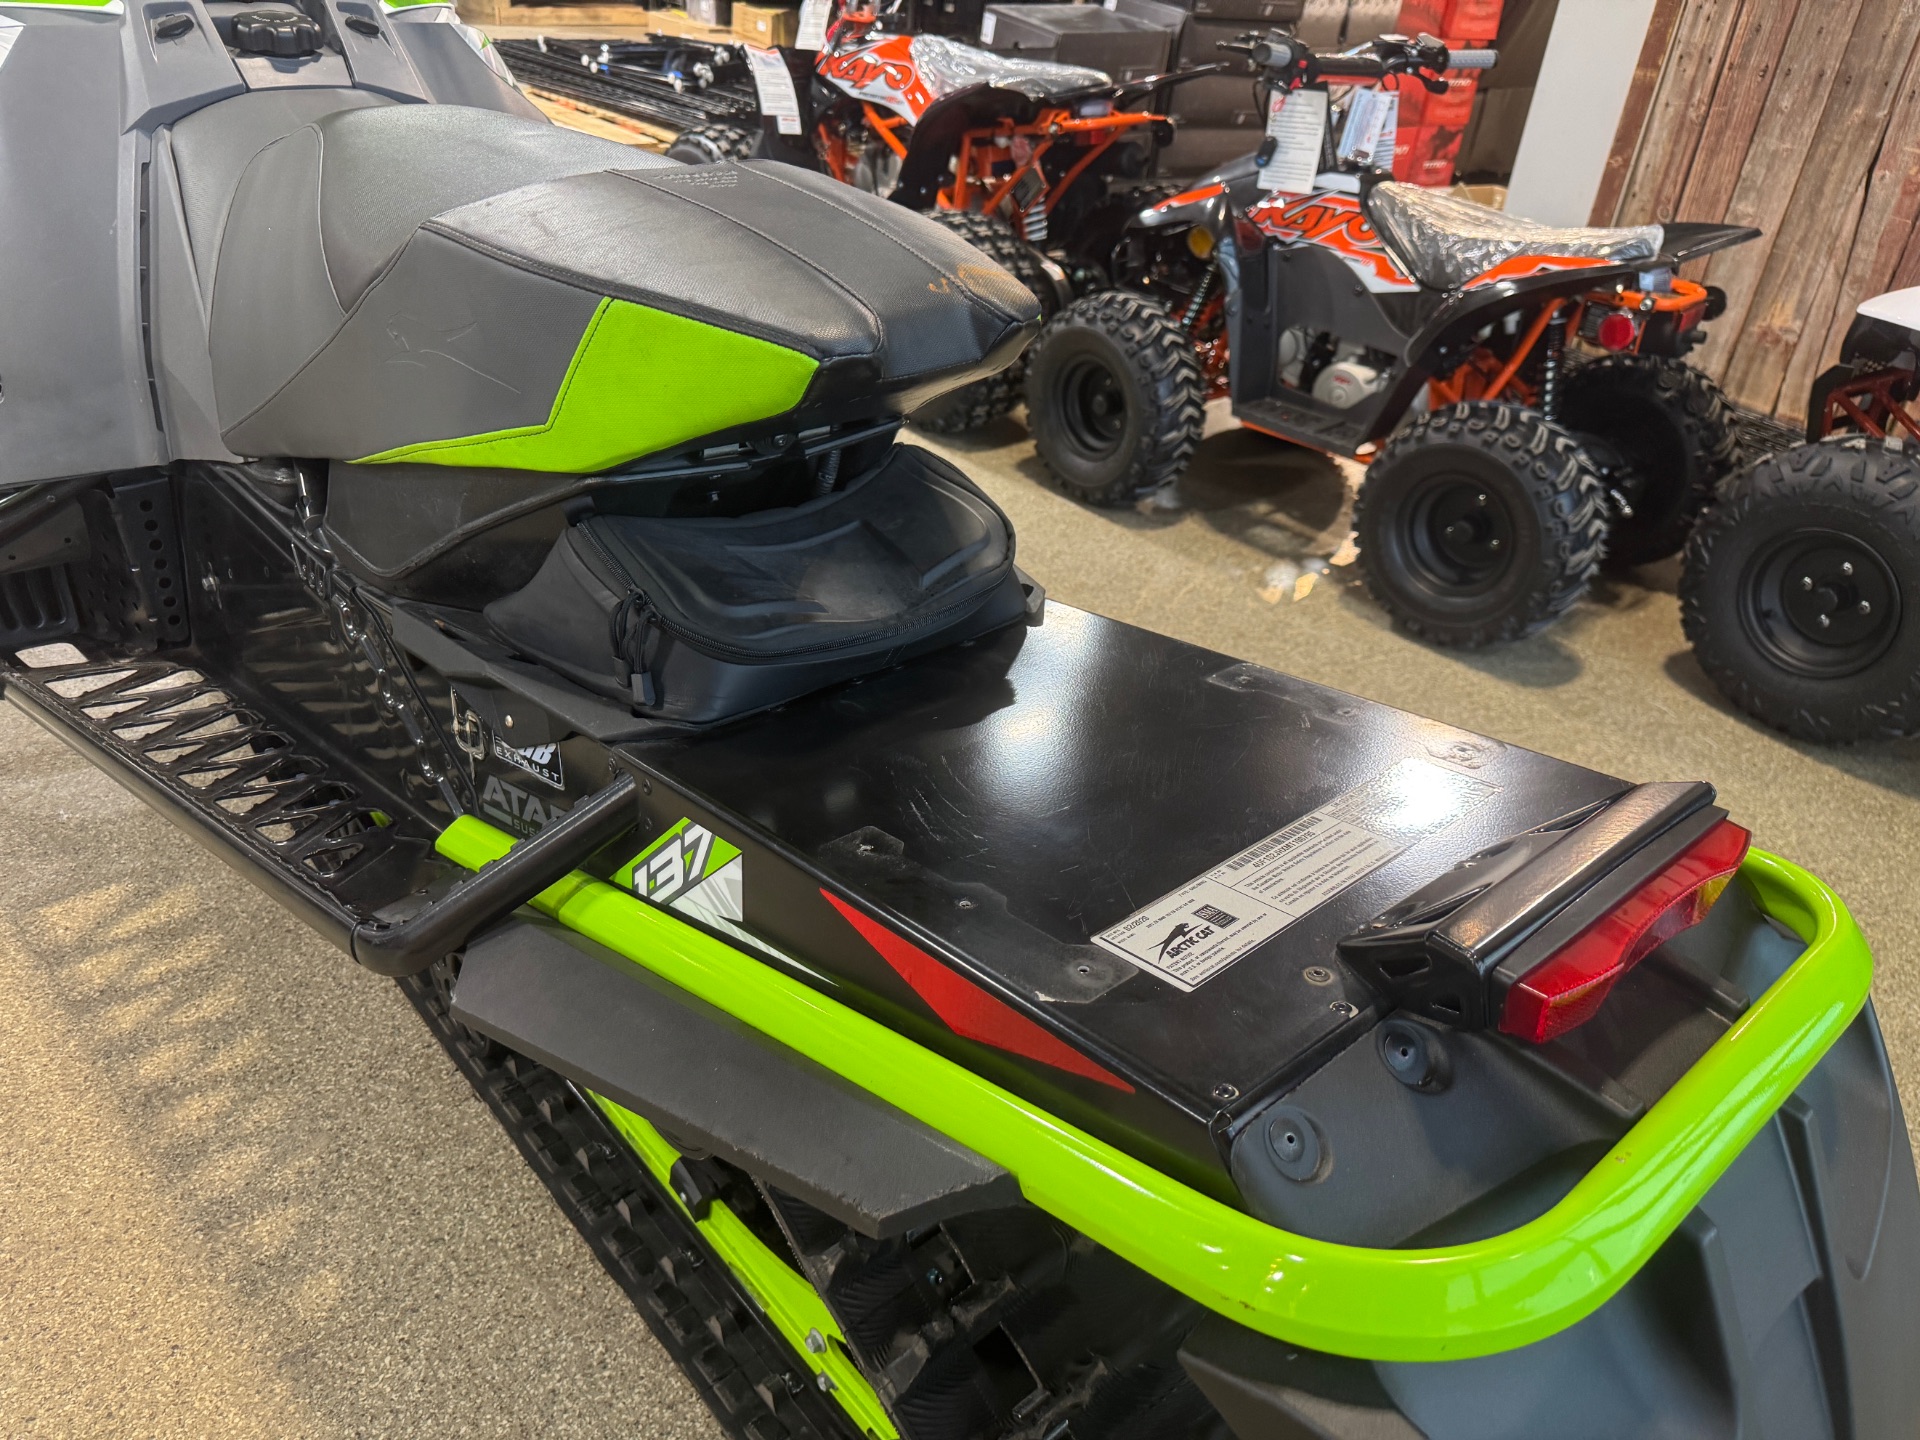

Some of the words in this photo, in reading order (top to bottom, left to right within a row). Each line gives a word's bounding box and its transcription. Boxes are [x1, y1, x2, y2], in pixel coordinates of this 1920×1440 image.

[495, 745, 560, 782] EXHAUST
[634, 823, 713, 903] 137
[1163, 936, 1199, 957] ARCTIC
[1193, 925, 1217, 939] CAT
